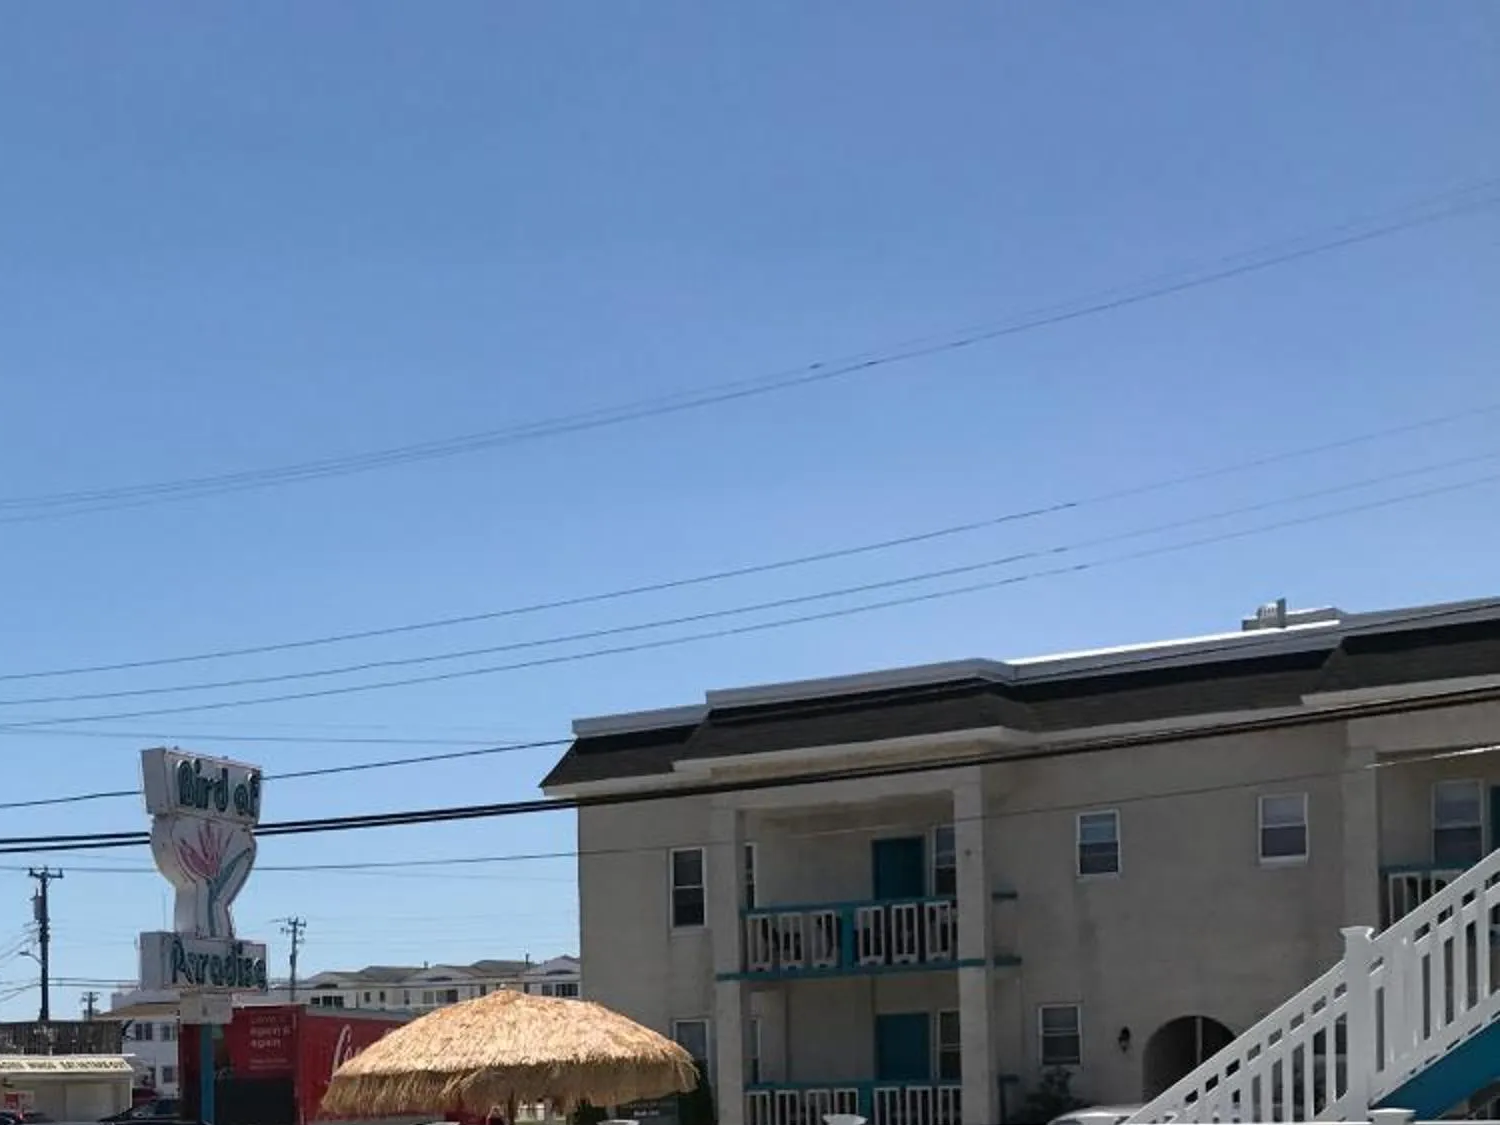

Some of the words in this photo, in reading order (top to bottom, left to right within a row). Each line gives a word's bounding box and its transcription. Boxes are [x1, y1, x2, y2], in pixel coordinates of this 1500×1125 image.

[178, 757, 228, 813] Bird
[234, 767, 260, 818] of
[171, 940, 268, 992] Paradise
